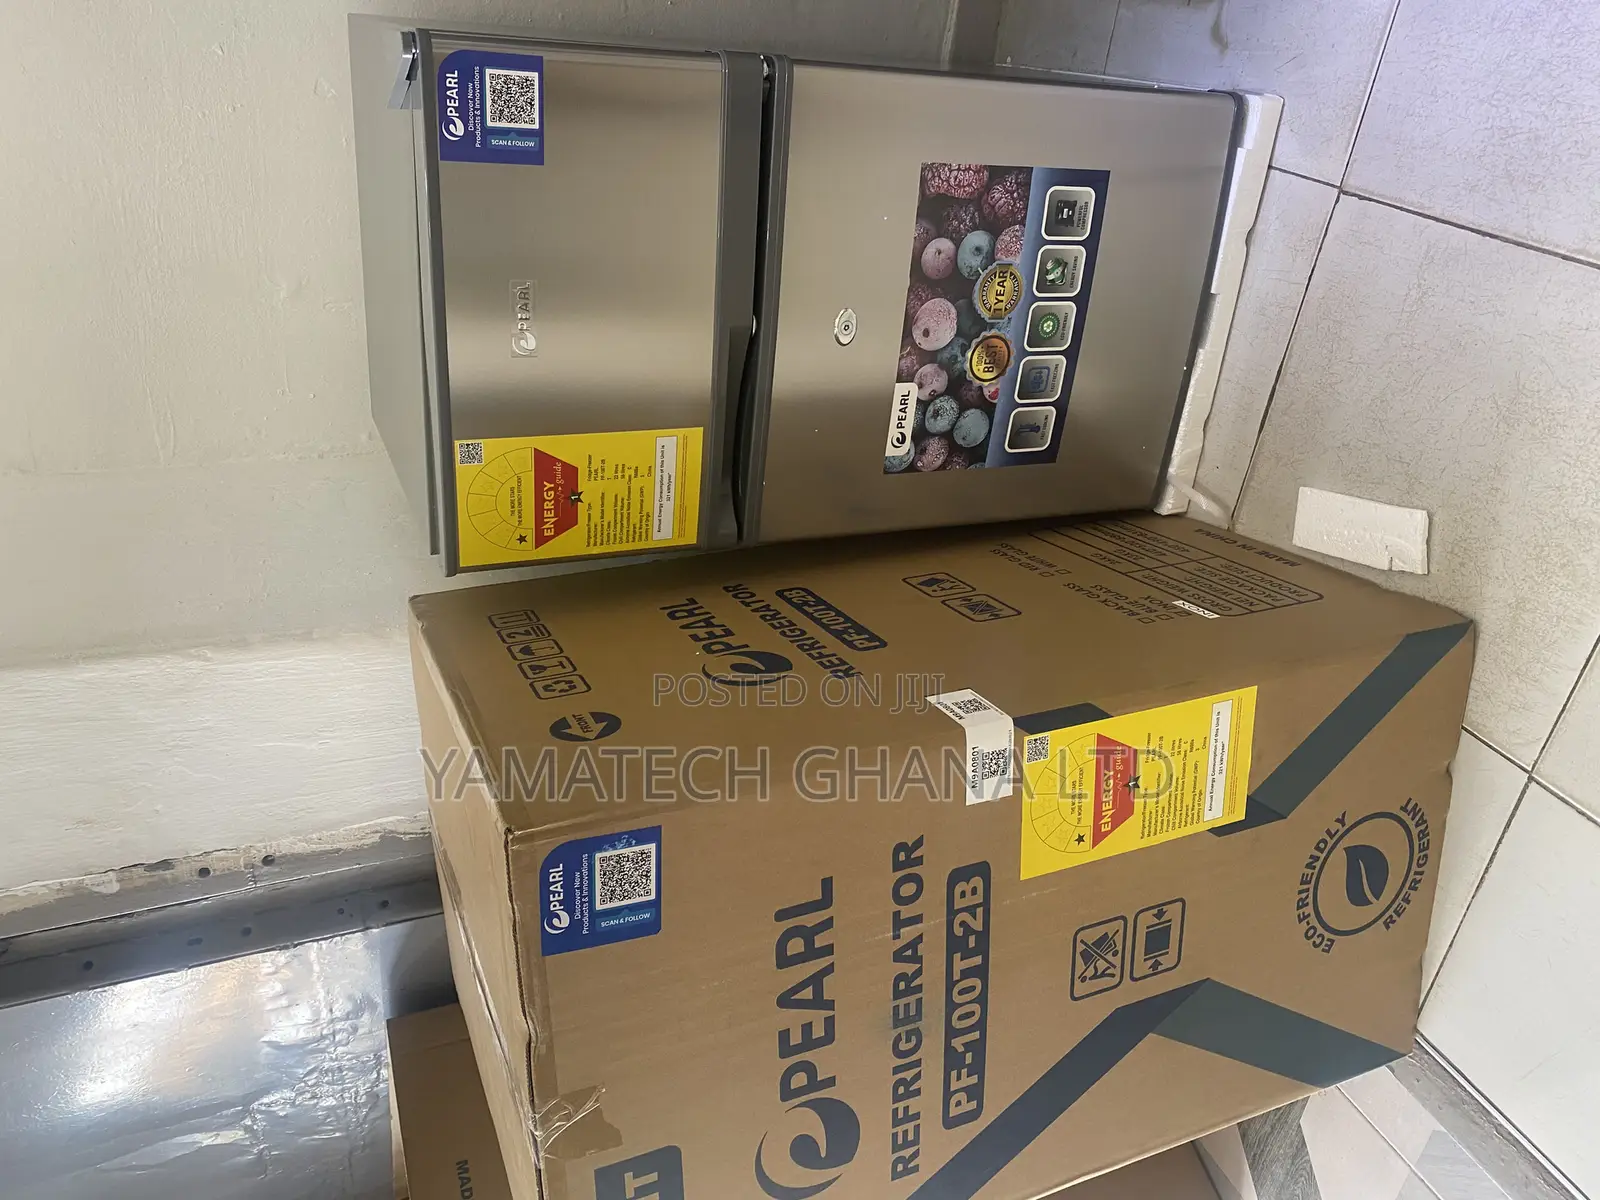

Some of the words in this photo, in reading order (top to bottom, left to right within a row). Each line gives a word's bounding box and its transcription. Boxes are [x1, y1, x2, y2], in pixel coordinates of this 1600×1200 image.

[446, 70, 459, 116] PEARL
[981, 274, 996, 309] WARRANTY
[994, 270, 1008, 305] YEAR
[1005, 274, 1019, 310] WARRANTY
[517, 282, 531, 331] PEARL
[976, 350, 984, 367] 100%
[983, 343, 998, 373] BEST
[896, 390, 910, 429] PEARL
[553, 462, 564, 484] guide
[540, 481, 559, 536] ENERGY
[1193, 528, 1238, 544] CHINA
[990, 549, 1021, 562] GLASS
[1018, 562, 1040, 571] RED
[1254, 550, 1302, 567] MADE
[1062, 582, 1100, 598] GLASS
[1089, 584, 1128, 600] GLASS
[1220, 576, 1284, 602] PACKAGE
[1244, 572, 1308, 598] PRODUCT
[1097, 598, 1142, 616] BLACK
[1124, 600, 1158, 613] BLUE
[1139, 596, 1177, 610] INOX
[1182, 602, 1214, 618] INOX
[1187, 594, 1233, 612] GROSS
[1232, 596, 1260, 606] NET
[659, 597, 750, 655] PEARL
[722, 583, 864, 681] REFRIGERATOR
[784, 589, 880, 649] PF-100T-2B
[572, 714, 594, 734] FRONT
[971, 746, 979, 789] M9A0801
[1114, 745, 1123, 770] guide
[1210, 745, 1218, 776] Consumption
[1099, 769, 1116, 832] ENERGY
[1382, 797, 1430, 931] REFRIGERANT
[549, 864, 564, 911] PEARL
[1296, 810, 1347, 954] ECO-FRIENDLY
[582, 903, 590, 934] Products
[601, 919, 619, 927] SCAN
[624, 912, 650, 922] FOLLOW
[774, 875, 837, 1103] PEARL
[948, 875, 984, 1118] PF-100T-2B
[891, 834, 924, 1182] REFRIGERATOR
